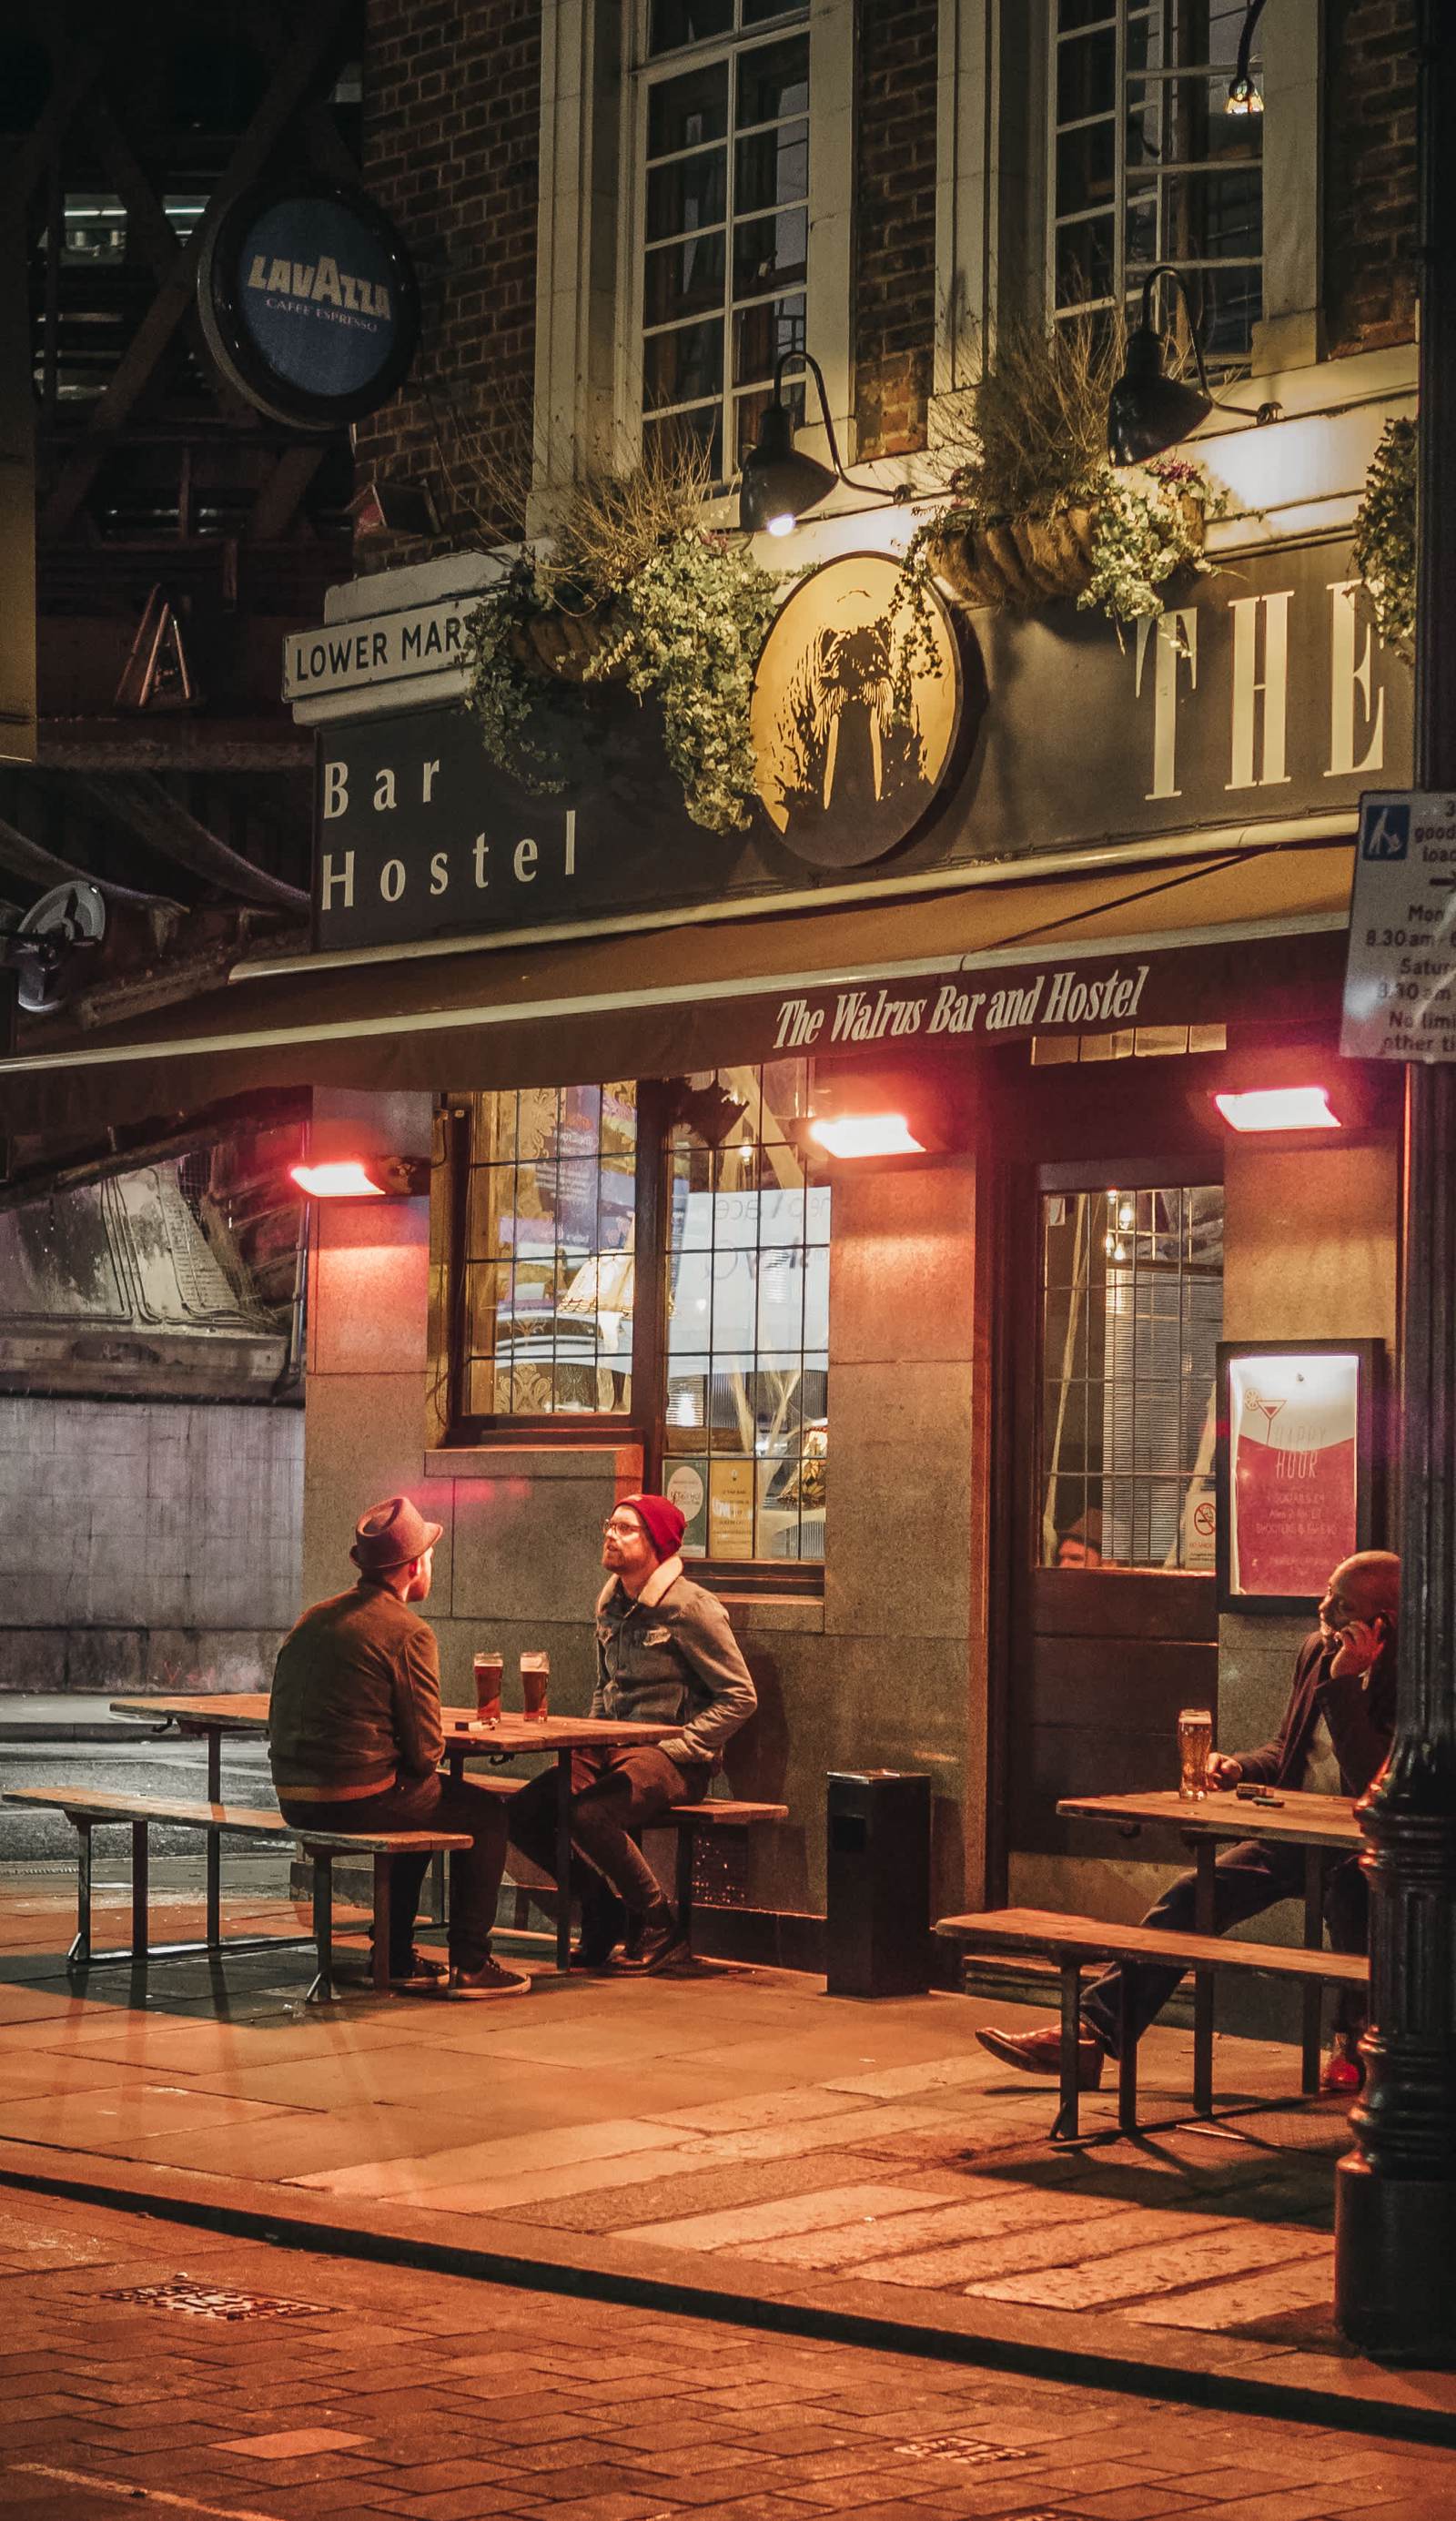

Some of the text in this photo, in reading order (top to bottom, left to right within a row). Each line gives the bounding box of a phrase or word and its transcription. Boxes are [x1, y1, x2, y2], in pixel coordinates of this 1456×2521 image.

[248, 255, 391, 319] LAVAZZA
[297, 632, 388, 682] LOWER
[1136, 579, 1384, 801] THE
[324, 759, 440, 819] Bar
[321, 810, 576, 911] Hostel
[773, 966, 1150, 1049] The Walrus Bar and Hostel
[1276, 1450, 1319, 1479] HOUR
